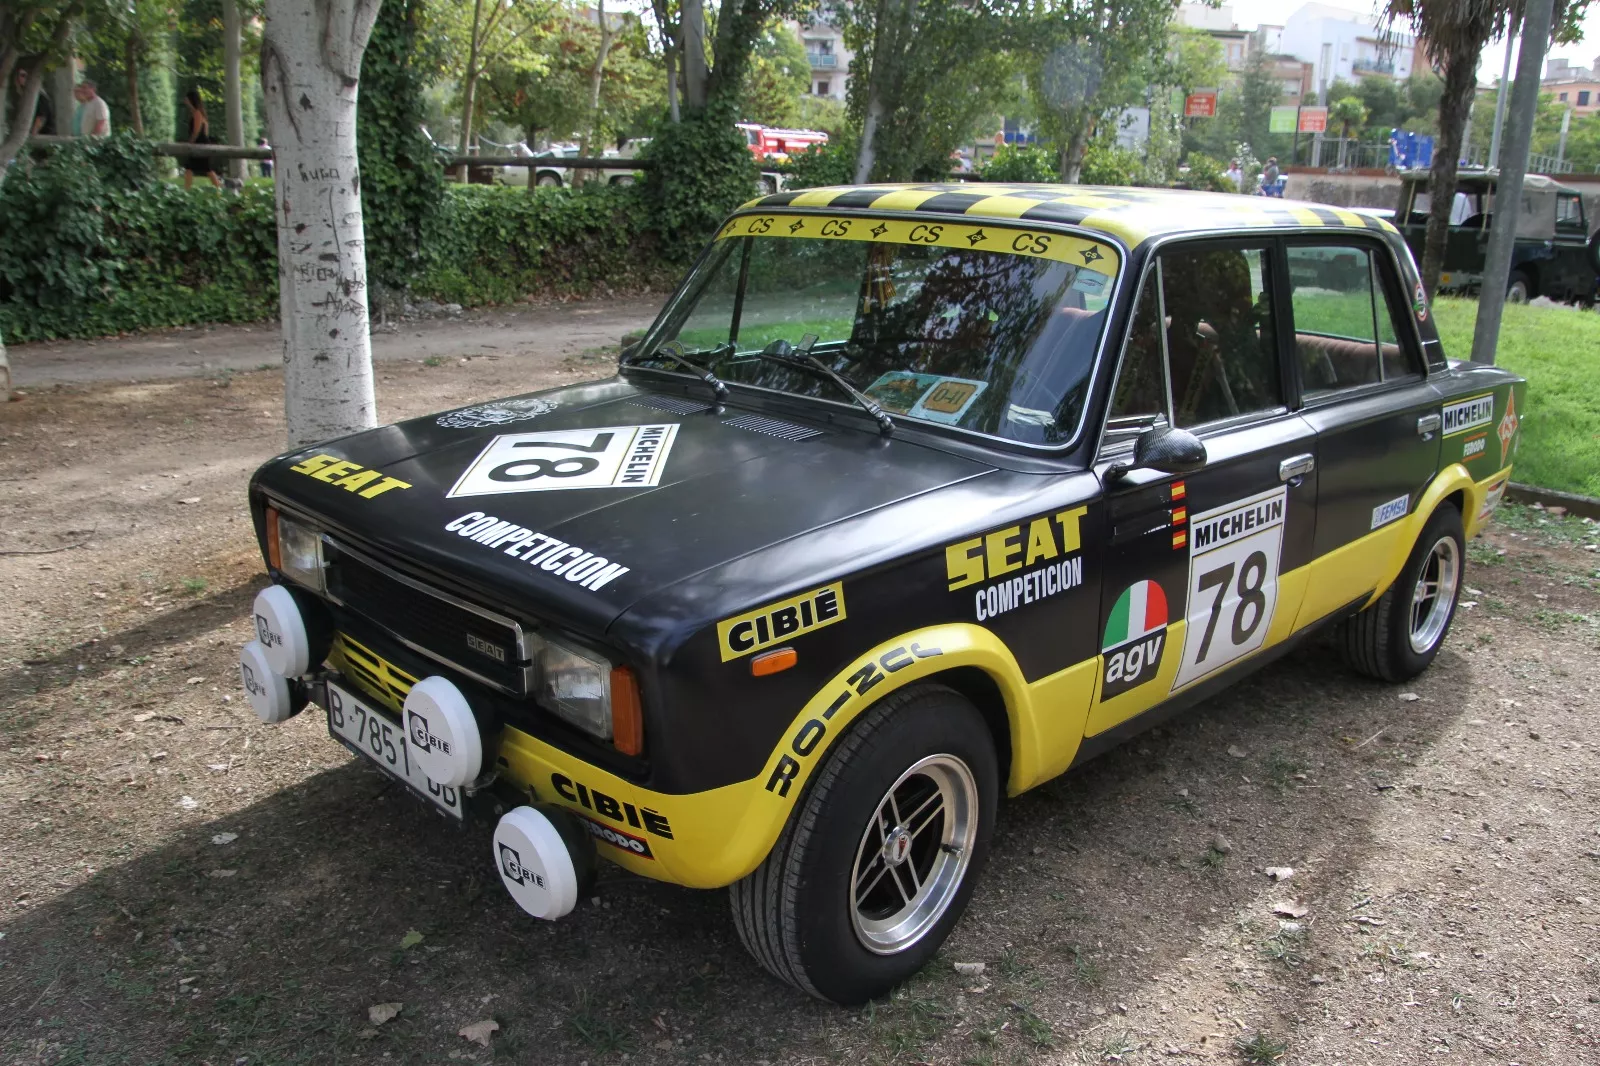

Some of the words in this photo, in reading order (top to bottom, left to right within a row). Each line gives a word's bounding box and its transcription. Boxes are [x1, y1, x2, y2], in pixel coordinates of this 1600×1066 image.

[747, 218, 774, 234] CS
[820, 219, 852, 237] CS
[908, 224, 944, 243] CS
[970, 233, 983, 241] CS
[1011, 233, 1052, 254] CS
[1084, 250, 1099, 259] CS
[1444, 401, 1492, 430] MICHELIN
[289, 453, 413, 500] SEAT
[487, 432, 615, 483] 78
[621, 426, 664, 484] MICHELIN
[1194, 499, 1283, 549] MICHELIN
[1379, 497, 1407, 523] FEMSA
[444, 511, 631, 592] COMPETICION
[945, 505, 1088, 592] SEAT
[975, 556, 1082, 622] COMPETICION
[1194, 550, 1268, 666] 78
[466, 633, 505, 662] SEAT
[1105, 634, 1163, 683] agv
